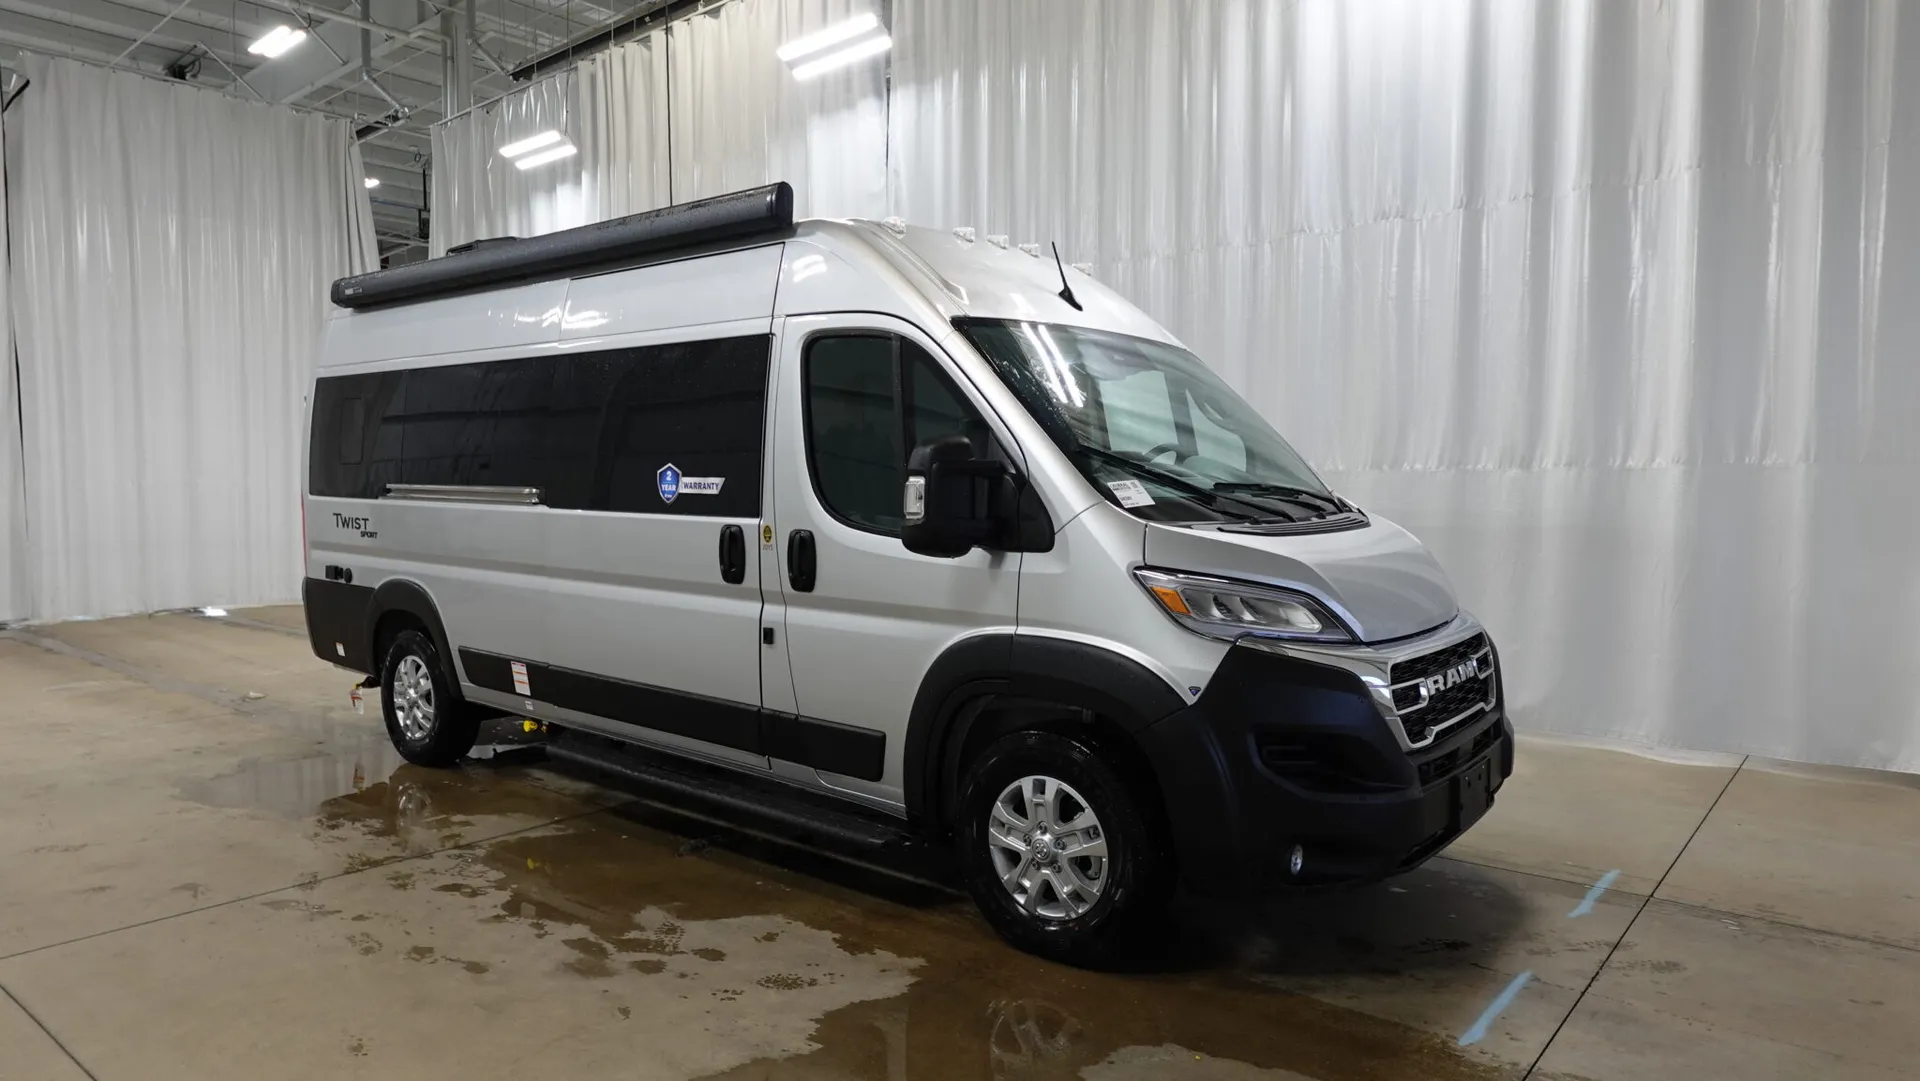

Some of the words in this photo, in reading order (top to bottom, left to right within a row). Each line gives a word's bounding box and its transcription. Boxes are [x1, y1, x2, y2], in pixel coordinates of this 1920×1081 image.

[666, 470, 672, 481] 2
[683, 482, 720, 490] WARRANTY
[360, 531, 378, 539] SPORT
[1427, 661, 1475, 695] RAM
